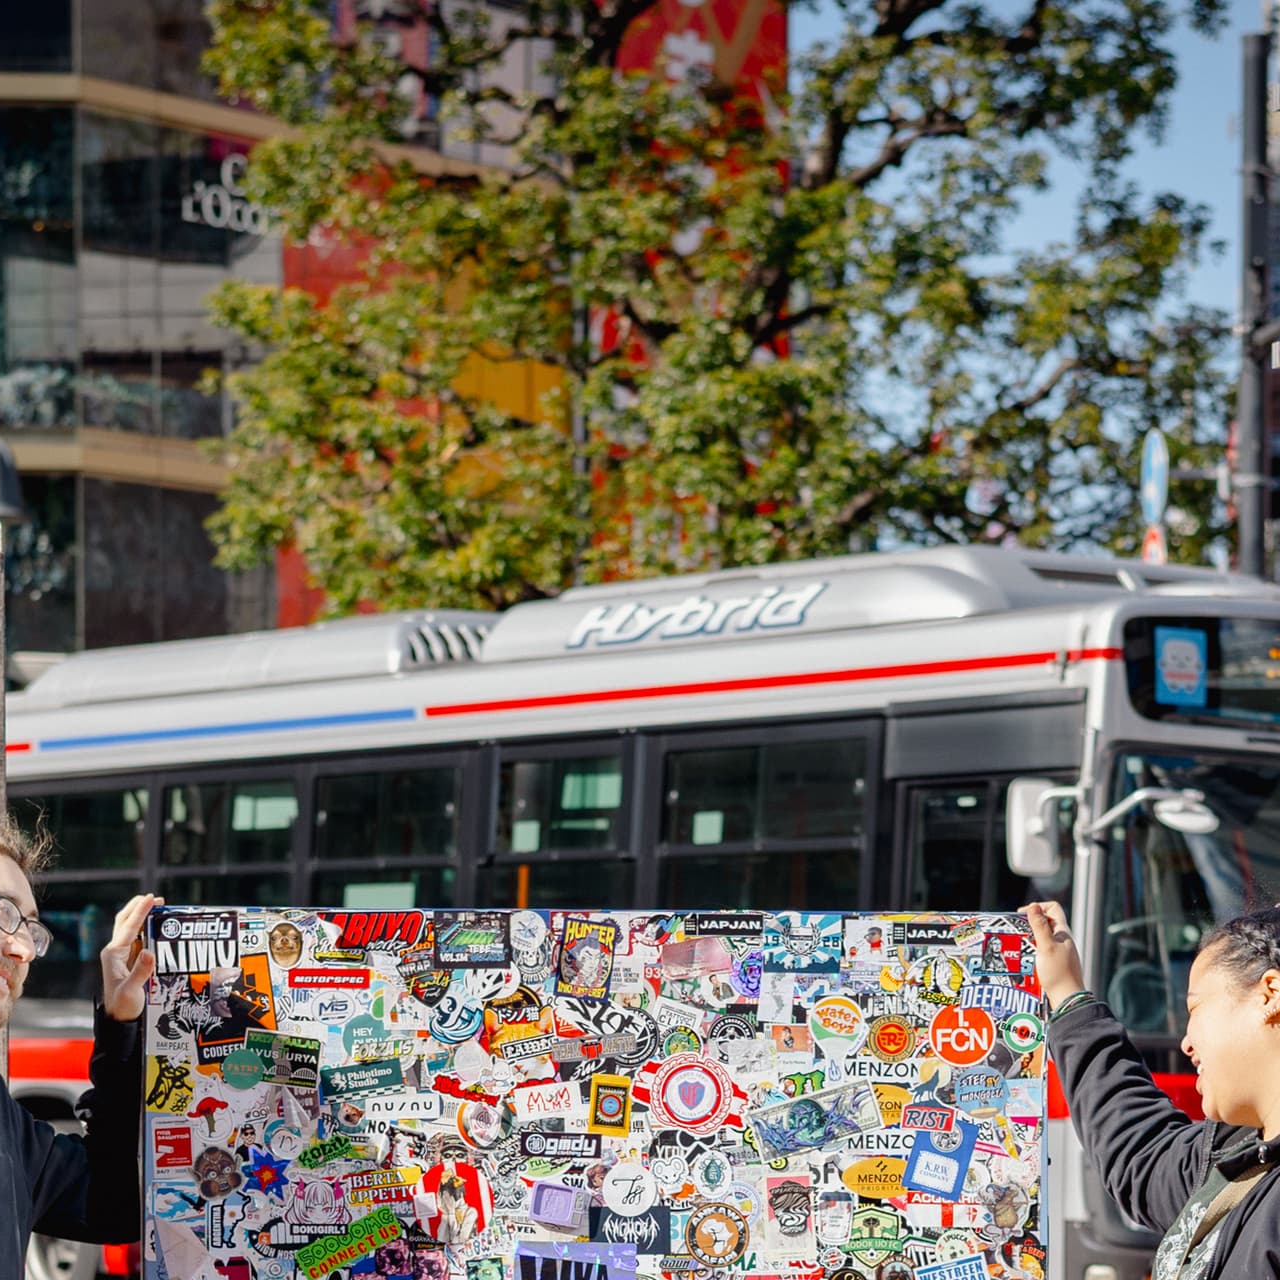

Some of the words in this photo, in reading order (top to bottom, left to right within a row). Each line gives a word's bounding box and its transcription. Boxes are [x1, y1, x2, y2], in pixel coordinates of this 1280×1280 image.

[565, 580, 829, 649] Hybrid
[565, 920, 617, 951] HUNTER
[398, 960, 432, 977] WRAP
[293, 975, 364, 984] MOTORSPEC
[352, 1026, 374, 1038] HEY
[935, 1028, 989, 1052] FCN
[346, 1067, 392, 1082] Philotimo
[347, 1077, 379, 1090] Studio
[906, 1108, 950, 1129] RIST
[860, 1184, 903, 1193] PRIORITA
[211, 1205, 223, 1248] ARGENTINA
[379, 1224, 400, 1240] US
